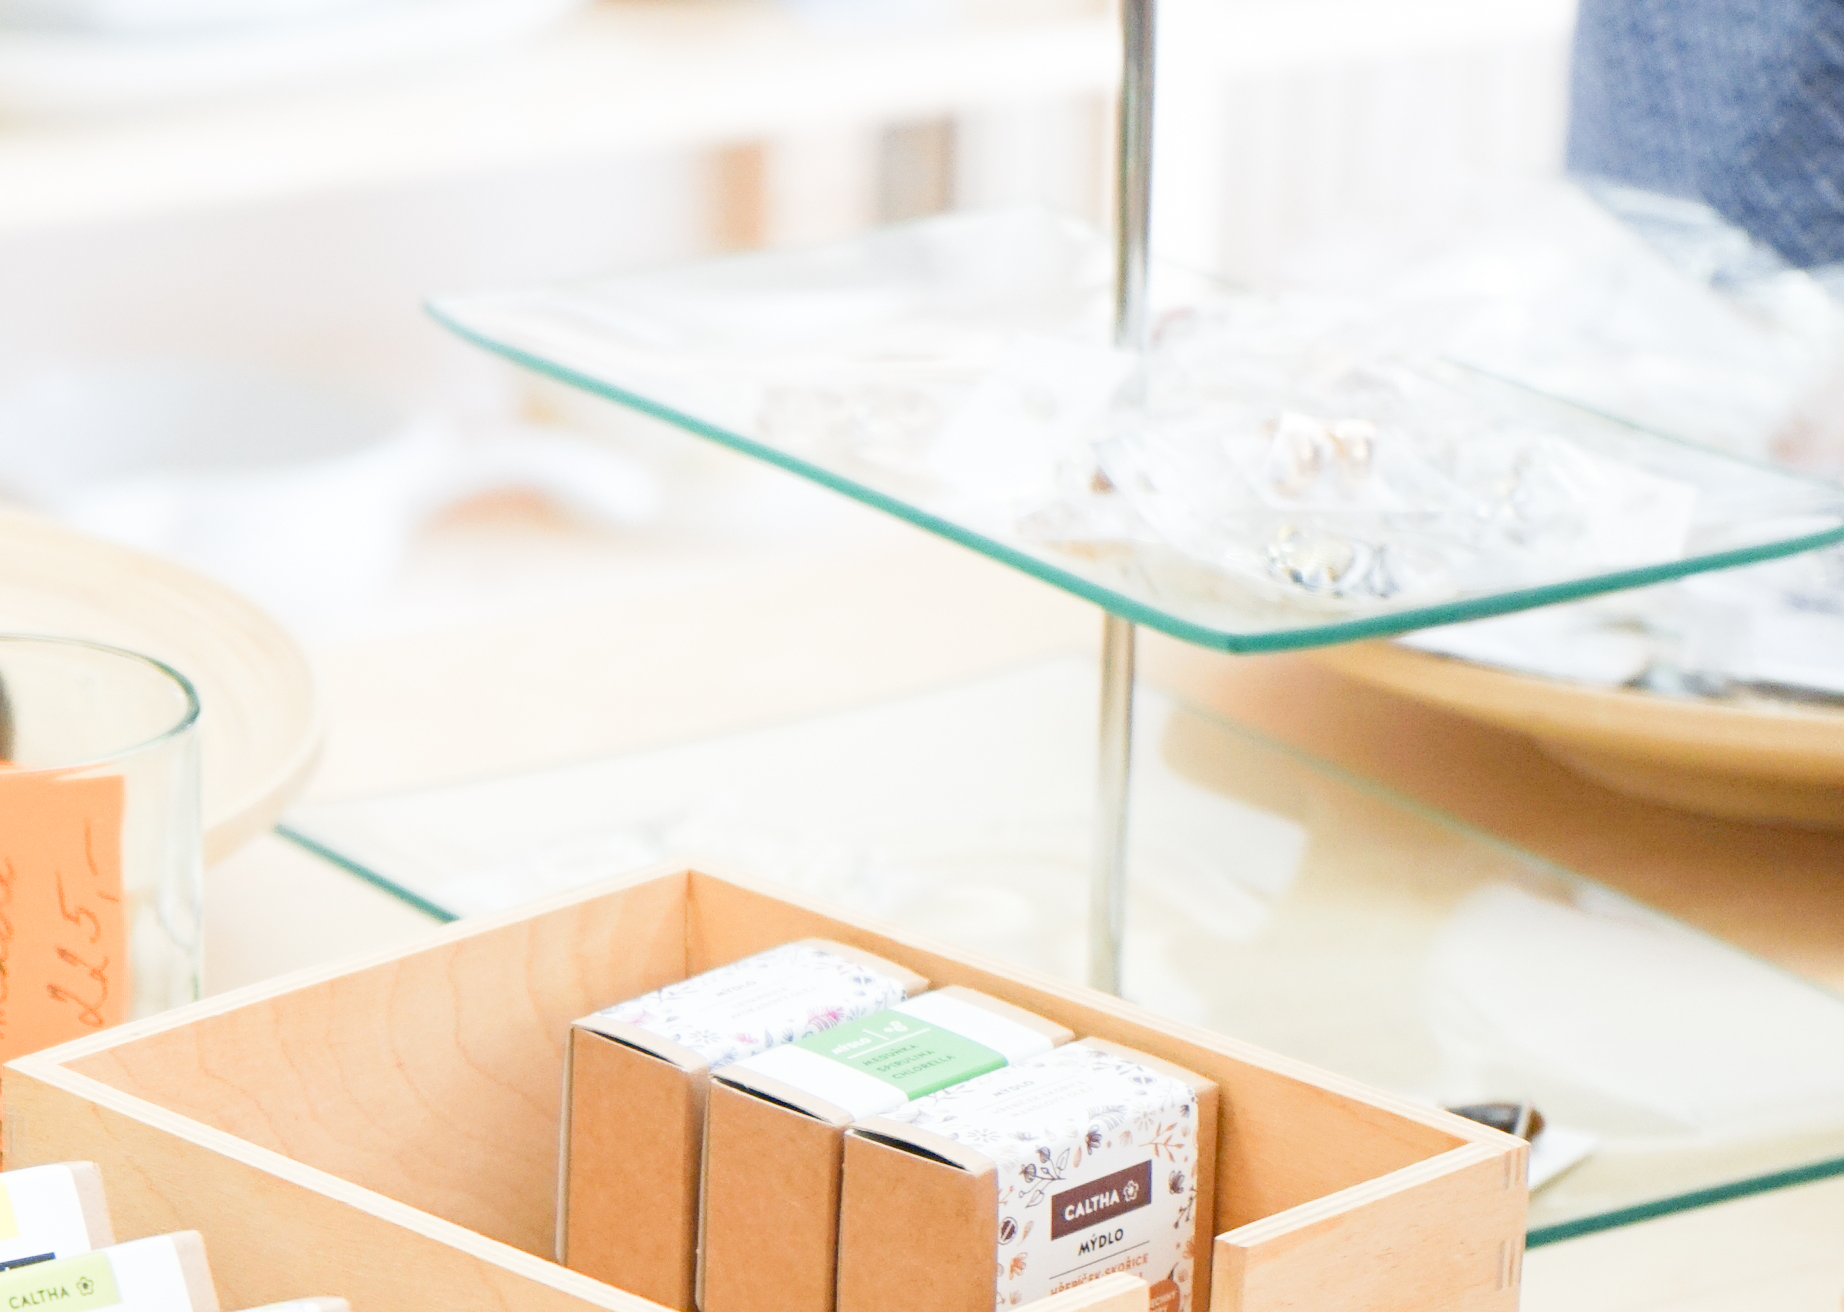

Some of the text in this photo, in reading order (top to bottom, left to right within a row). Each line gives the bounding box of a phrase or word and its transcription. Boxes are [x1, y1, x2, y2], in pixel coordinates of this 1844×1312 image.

[1063, 1189, 1120, 1221] CALTHA
[1078, 1228, 1124, 1256] MÝDLO
[9, 1285, 70, 1311] CALTHA
